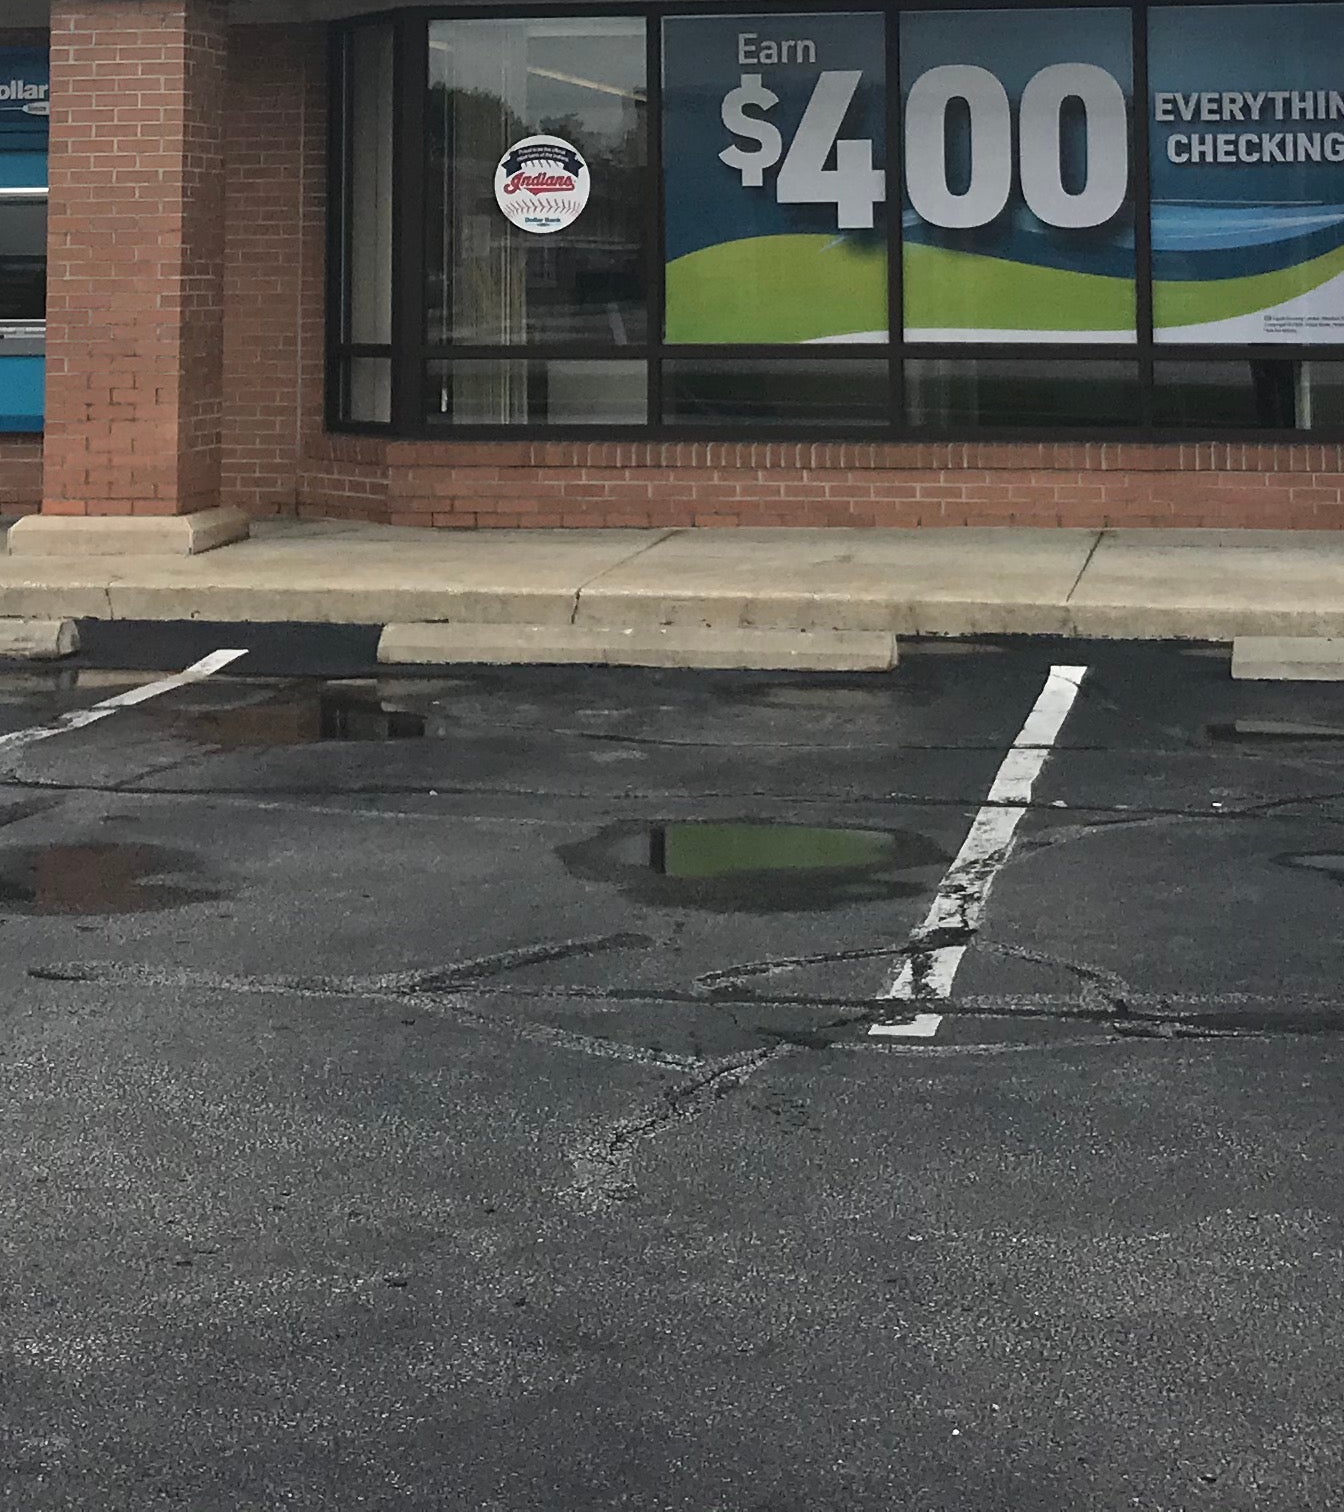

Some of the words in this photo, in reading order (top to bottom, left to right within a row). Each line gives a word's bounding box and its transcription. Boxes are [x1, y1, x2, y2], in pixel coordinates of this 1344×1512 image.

[738, 33, 816, 64] Earn
[718, 62, 1128, 229] $400
[503, 172, 575, 196] Indians
